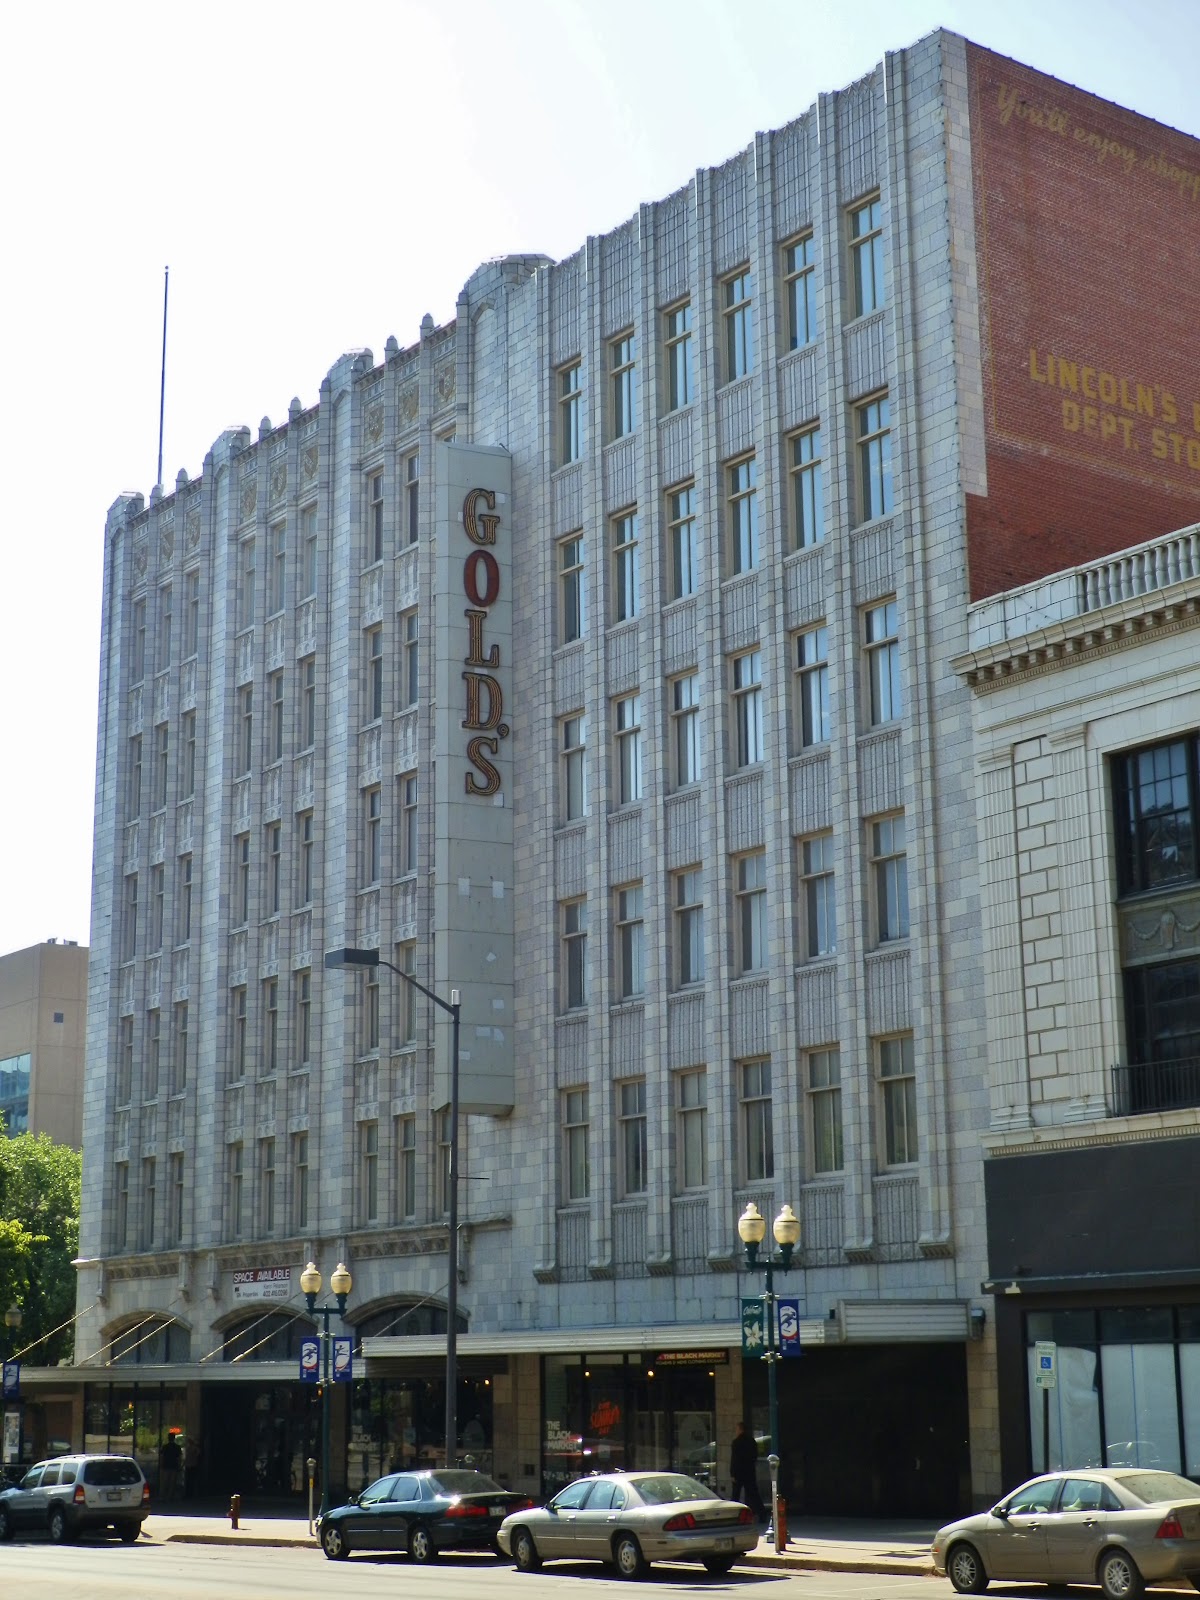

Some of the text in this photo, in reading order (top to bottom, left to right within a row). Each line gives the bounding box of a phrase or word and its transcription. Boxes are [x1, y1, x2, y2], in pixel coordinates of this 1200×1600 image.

[1030, 348, 1178, 424] LINCOLN'S
[233, 1268, 290, 1283] SPACE AVAILABLE
[698, 1351, 726, 1359] MARKET
[546, 1420, 560, 1430] THE
[547, 1430, 571, 1440] BLACK
[547, 1440, 577, 1450] MARKET
